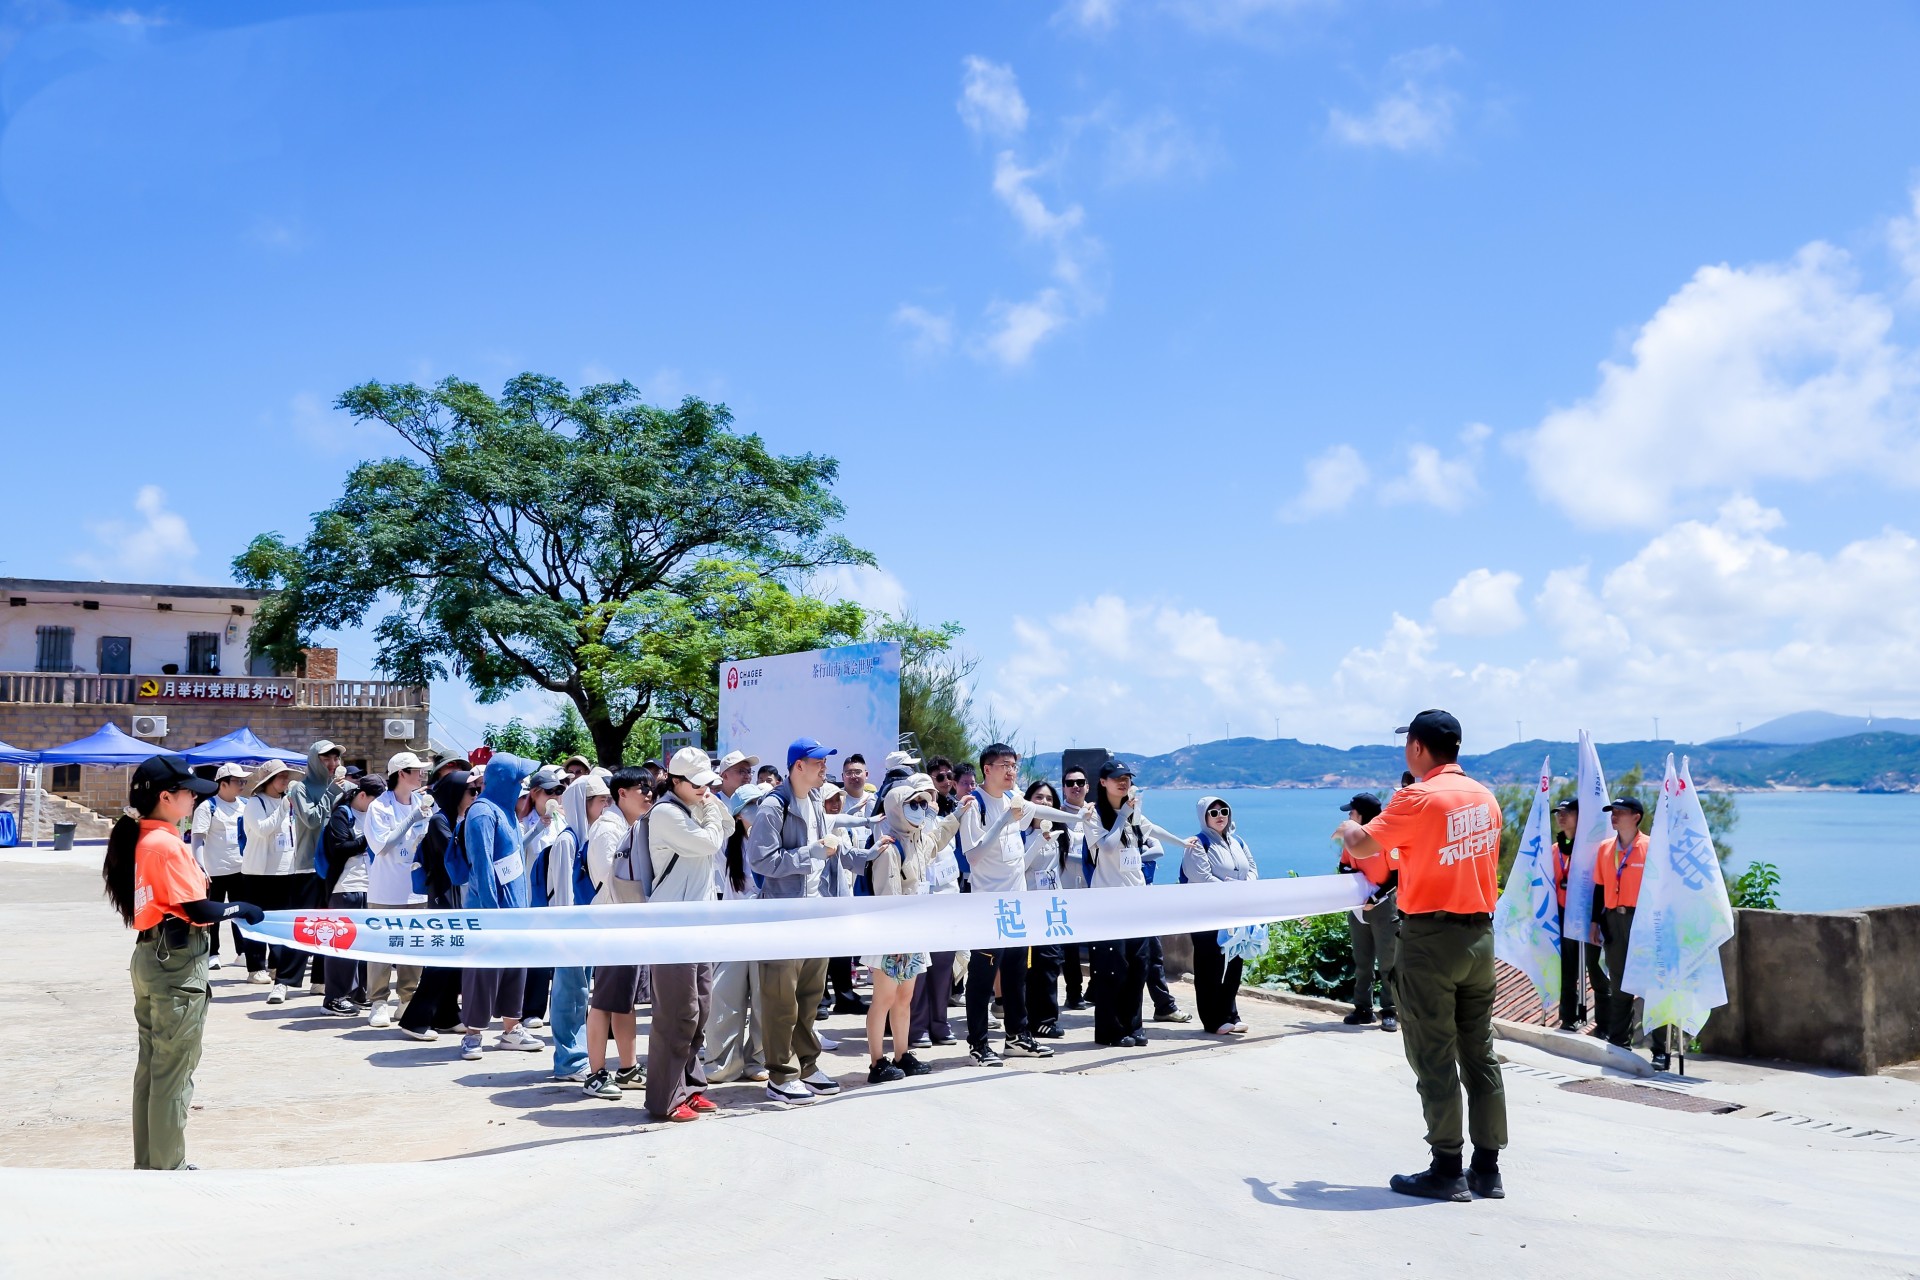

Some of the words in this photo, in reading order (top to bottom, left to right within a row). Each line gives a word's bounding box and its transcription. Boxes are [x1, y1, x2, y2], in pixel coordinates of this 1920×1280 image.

[740, 669, 762, 679] CHAGEE
[162, 680, 294, 699] 月举村党群服务中心
[1446, 803, 1491, 844] 团建
[365, 917, 483, 931] CHAGEE
[994, 896, 1074, 940] 起点
[388, 934, 465, 948] 霸王茶姬
